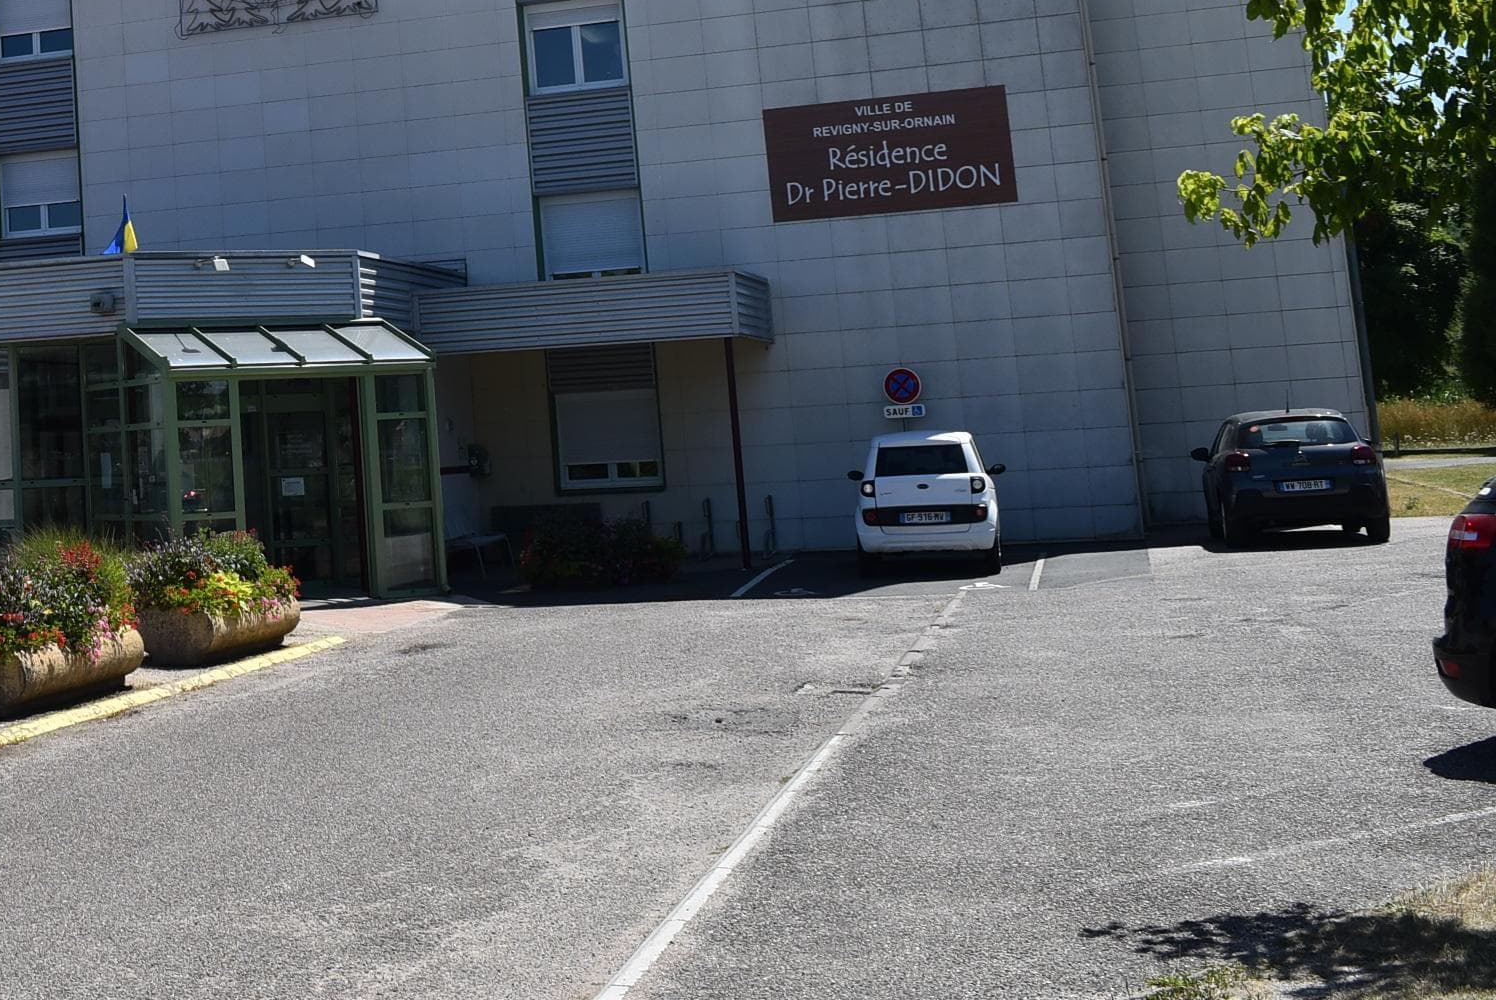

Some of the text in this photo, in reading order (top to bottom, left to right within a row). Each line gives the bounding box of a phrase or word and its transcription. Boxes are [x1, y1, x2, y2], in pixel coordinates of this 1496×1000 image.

[855, 101, 913, 117] VILLE DE
[813, 114, 956, 138] REVIGNY-SUR-ORNAIN
[829, 140, 948, 170] Résidence
[786, 163, 1001, 205] Dr Pierre-DIDON
[886, 407, 910, 416] SAUF
